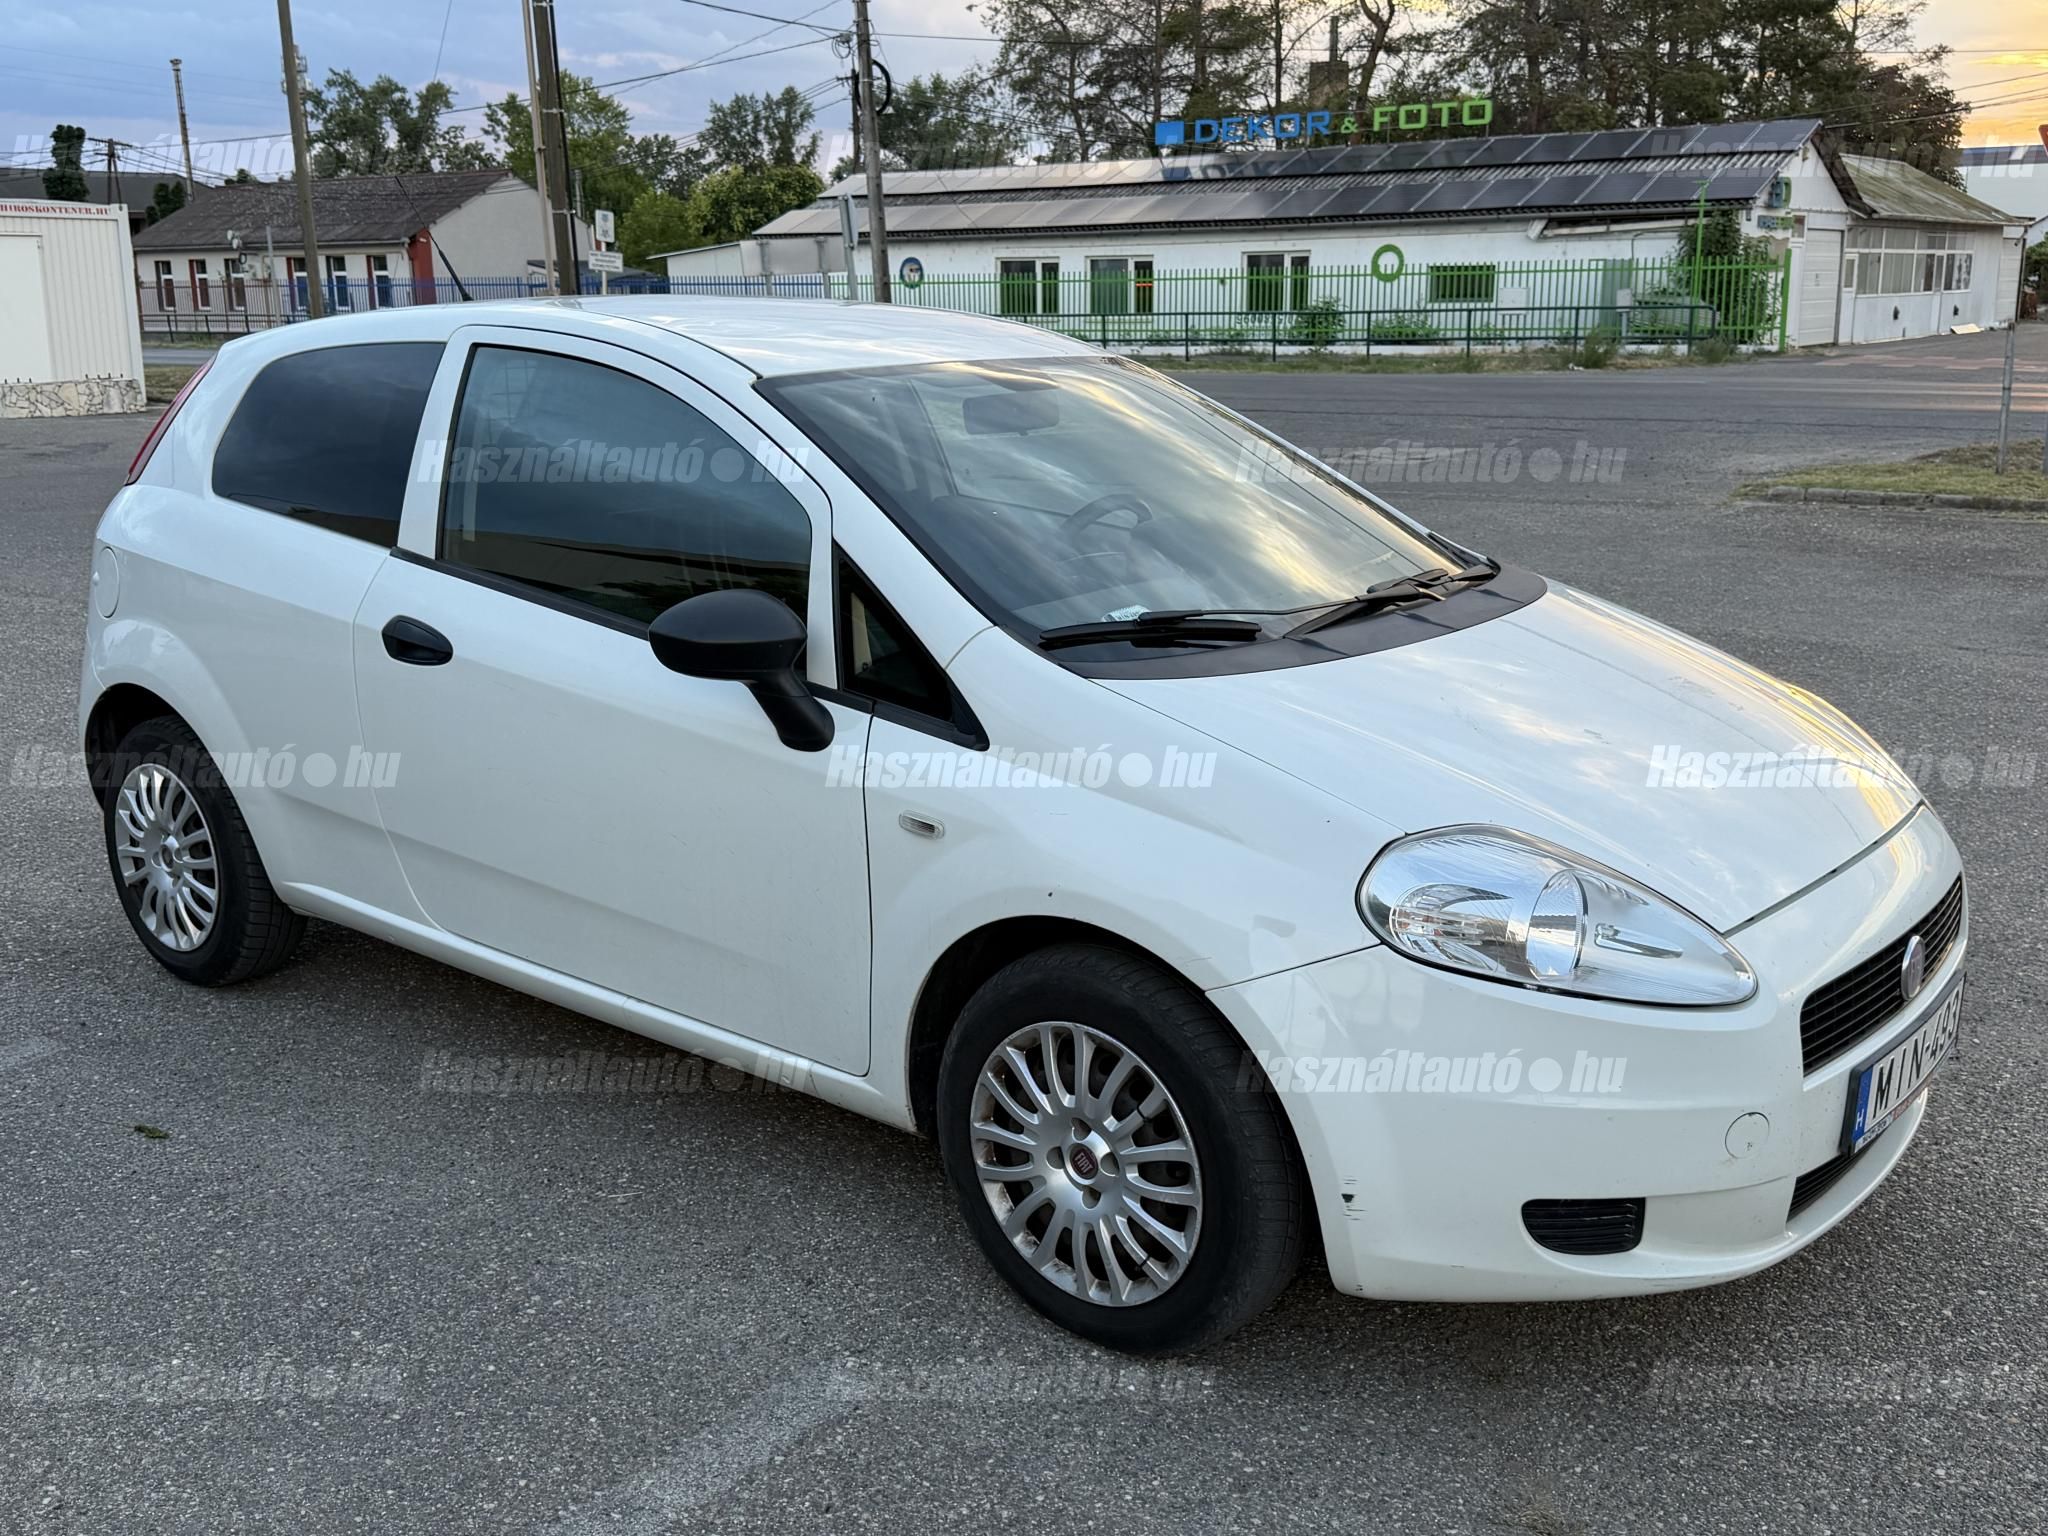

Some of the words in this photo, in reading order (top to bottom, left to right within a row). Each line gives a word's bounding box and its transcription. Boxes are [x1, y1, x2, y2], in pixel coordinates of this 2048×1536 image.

[1195, 111, 1331, 143] DEKOR
[1341, 115, 1358, 134] &
[1873, 989, 1960, 1119] MIN-493
[1855, 1111, 1865, 1131] H
[1075, 1152, 1094, 1173] FIAT
